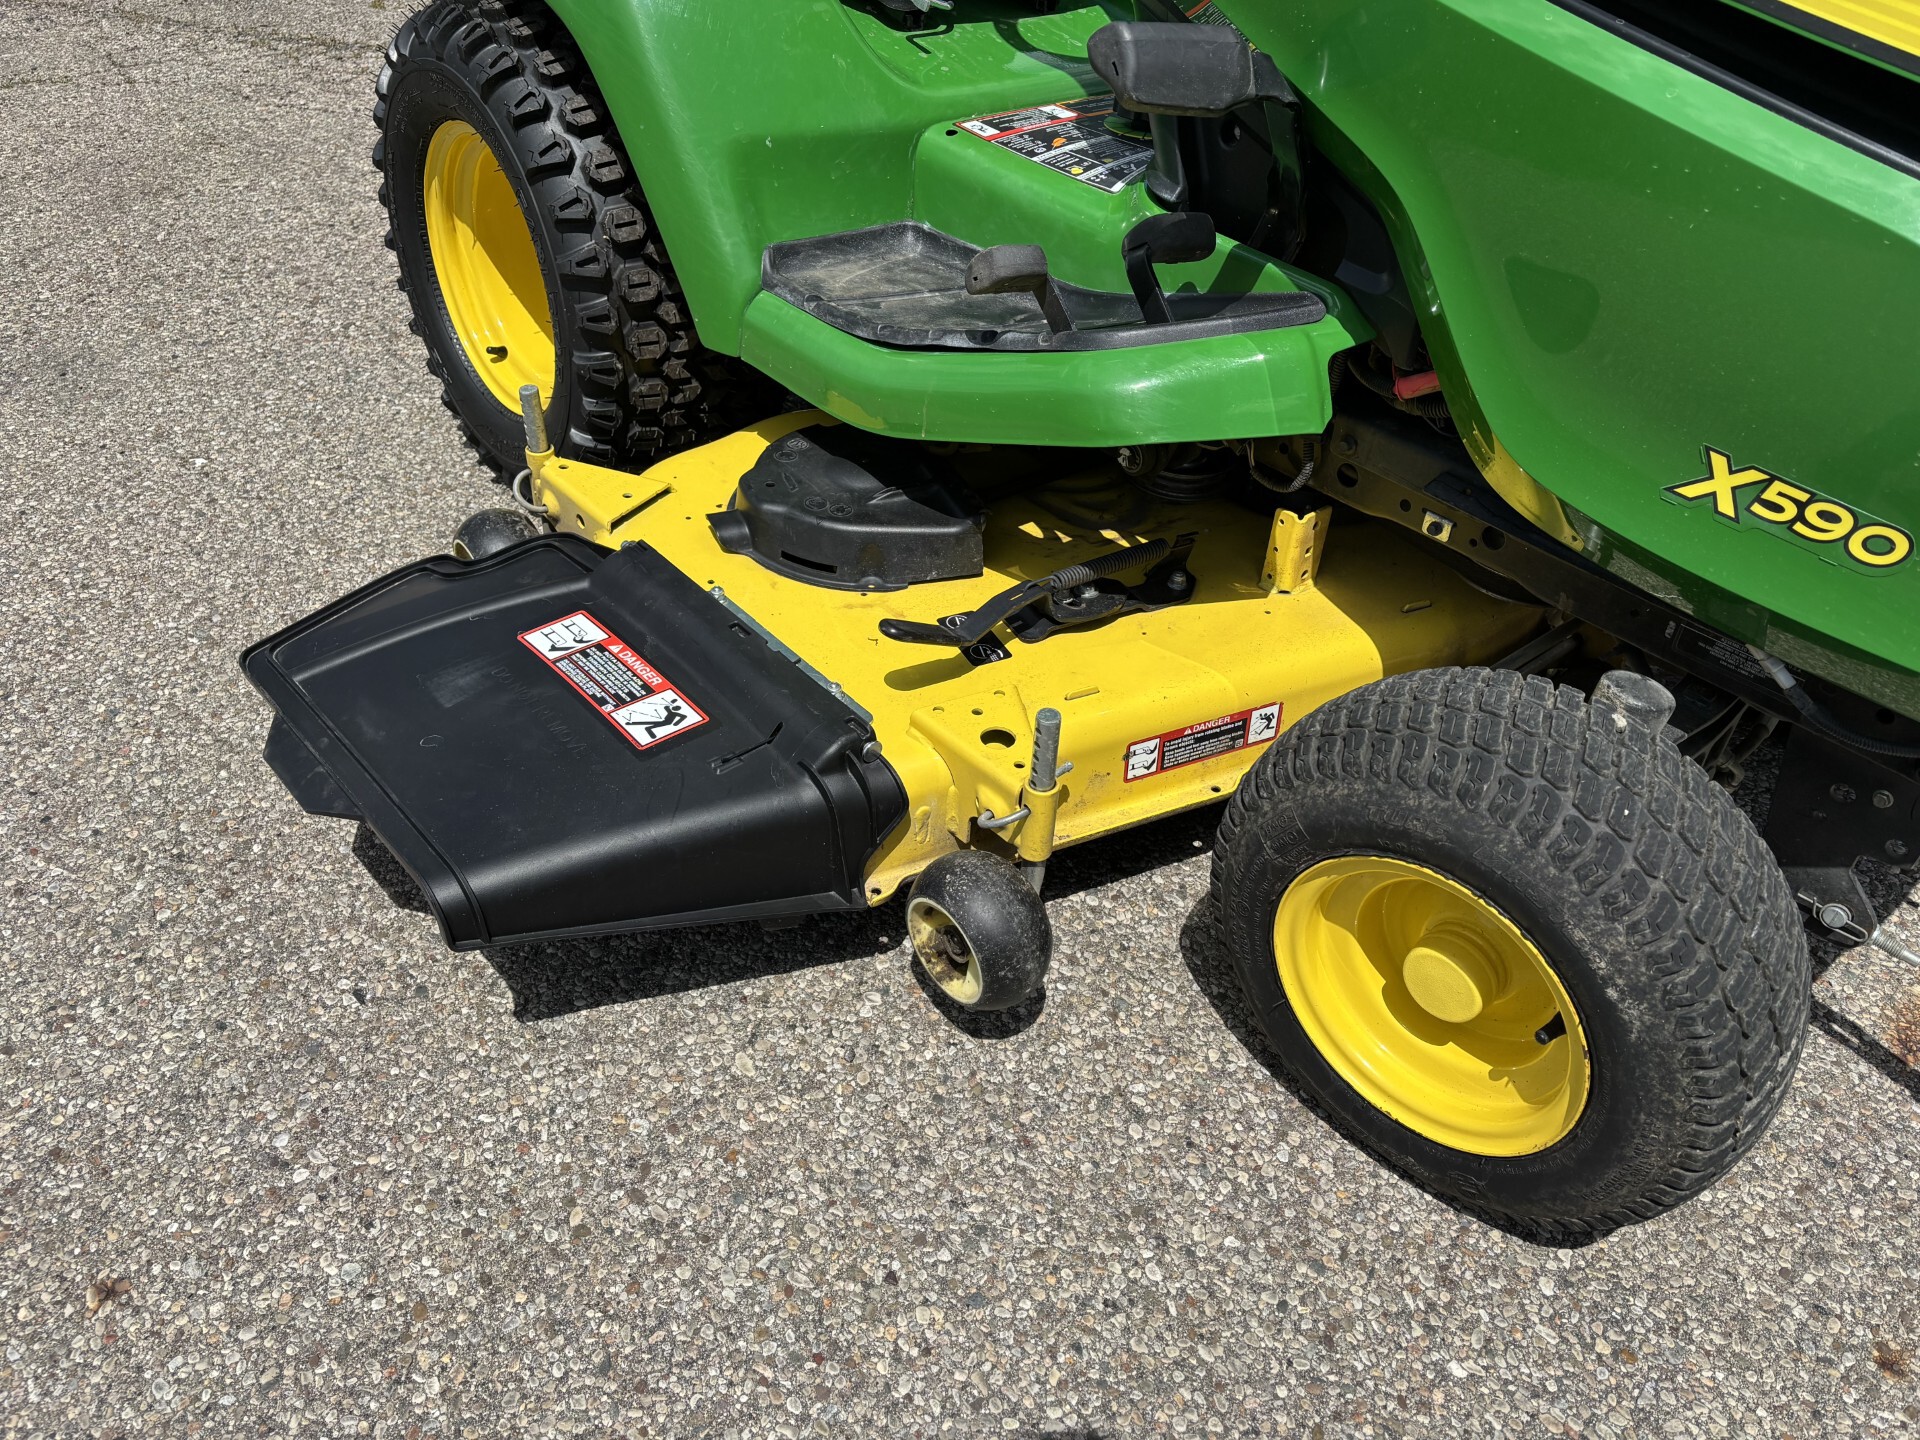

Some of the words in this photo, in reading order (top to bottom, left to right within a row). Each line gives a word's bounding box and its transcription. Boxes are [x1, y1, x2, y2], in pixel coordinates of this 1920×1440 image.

[1667, 446, 1913, 568] X590
[619, 650, 663, 686] DANGER
[1193, 716, 1230, 732] DANGER
